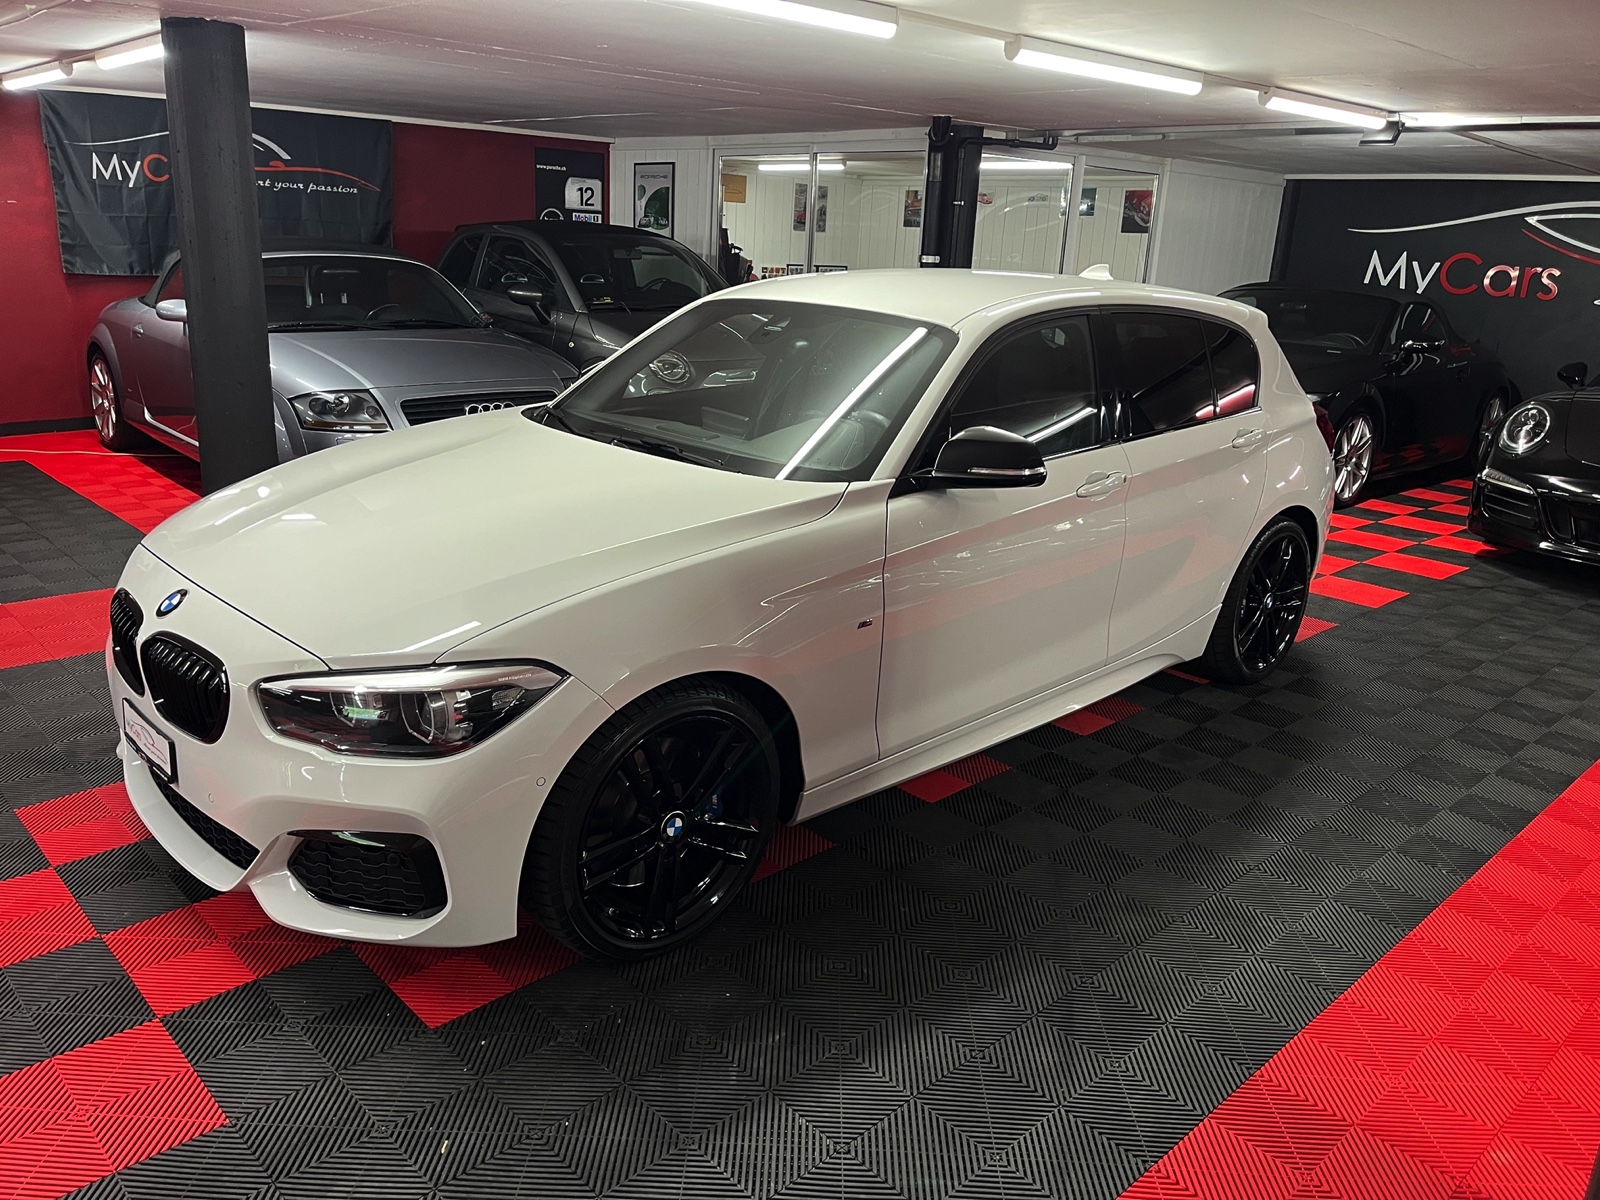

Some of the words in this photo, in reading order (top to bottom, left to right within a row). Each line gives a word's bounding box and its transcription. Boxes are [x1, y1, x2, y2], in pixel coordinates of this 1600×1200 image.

[92, 152, 170, 188] MyC
[273, 181, 304, 191] your
[307, 182, 358, 194] passion
[576, 186, 595, 206] 12
[574, 213, 592, 223] Mobil
[1363, 249, 1562, 301] MyCars
